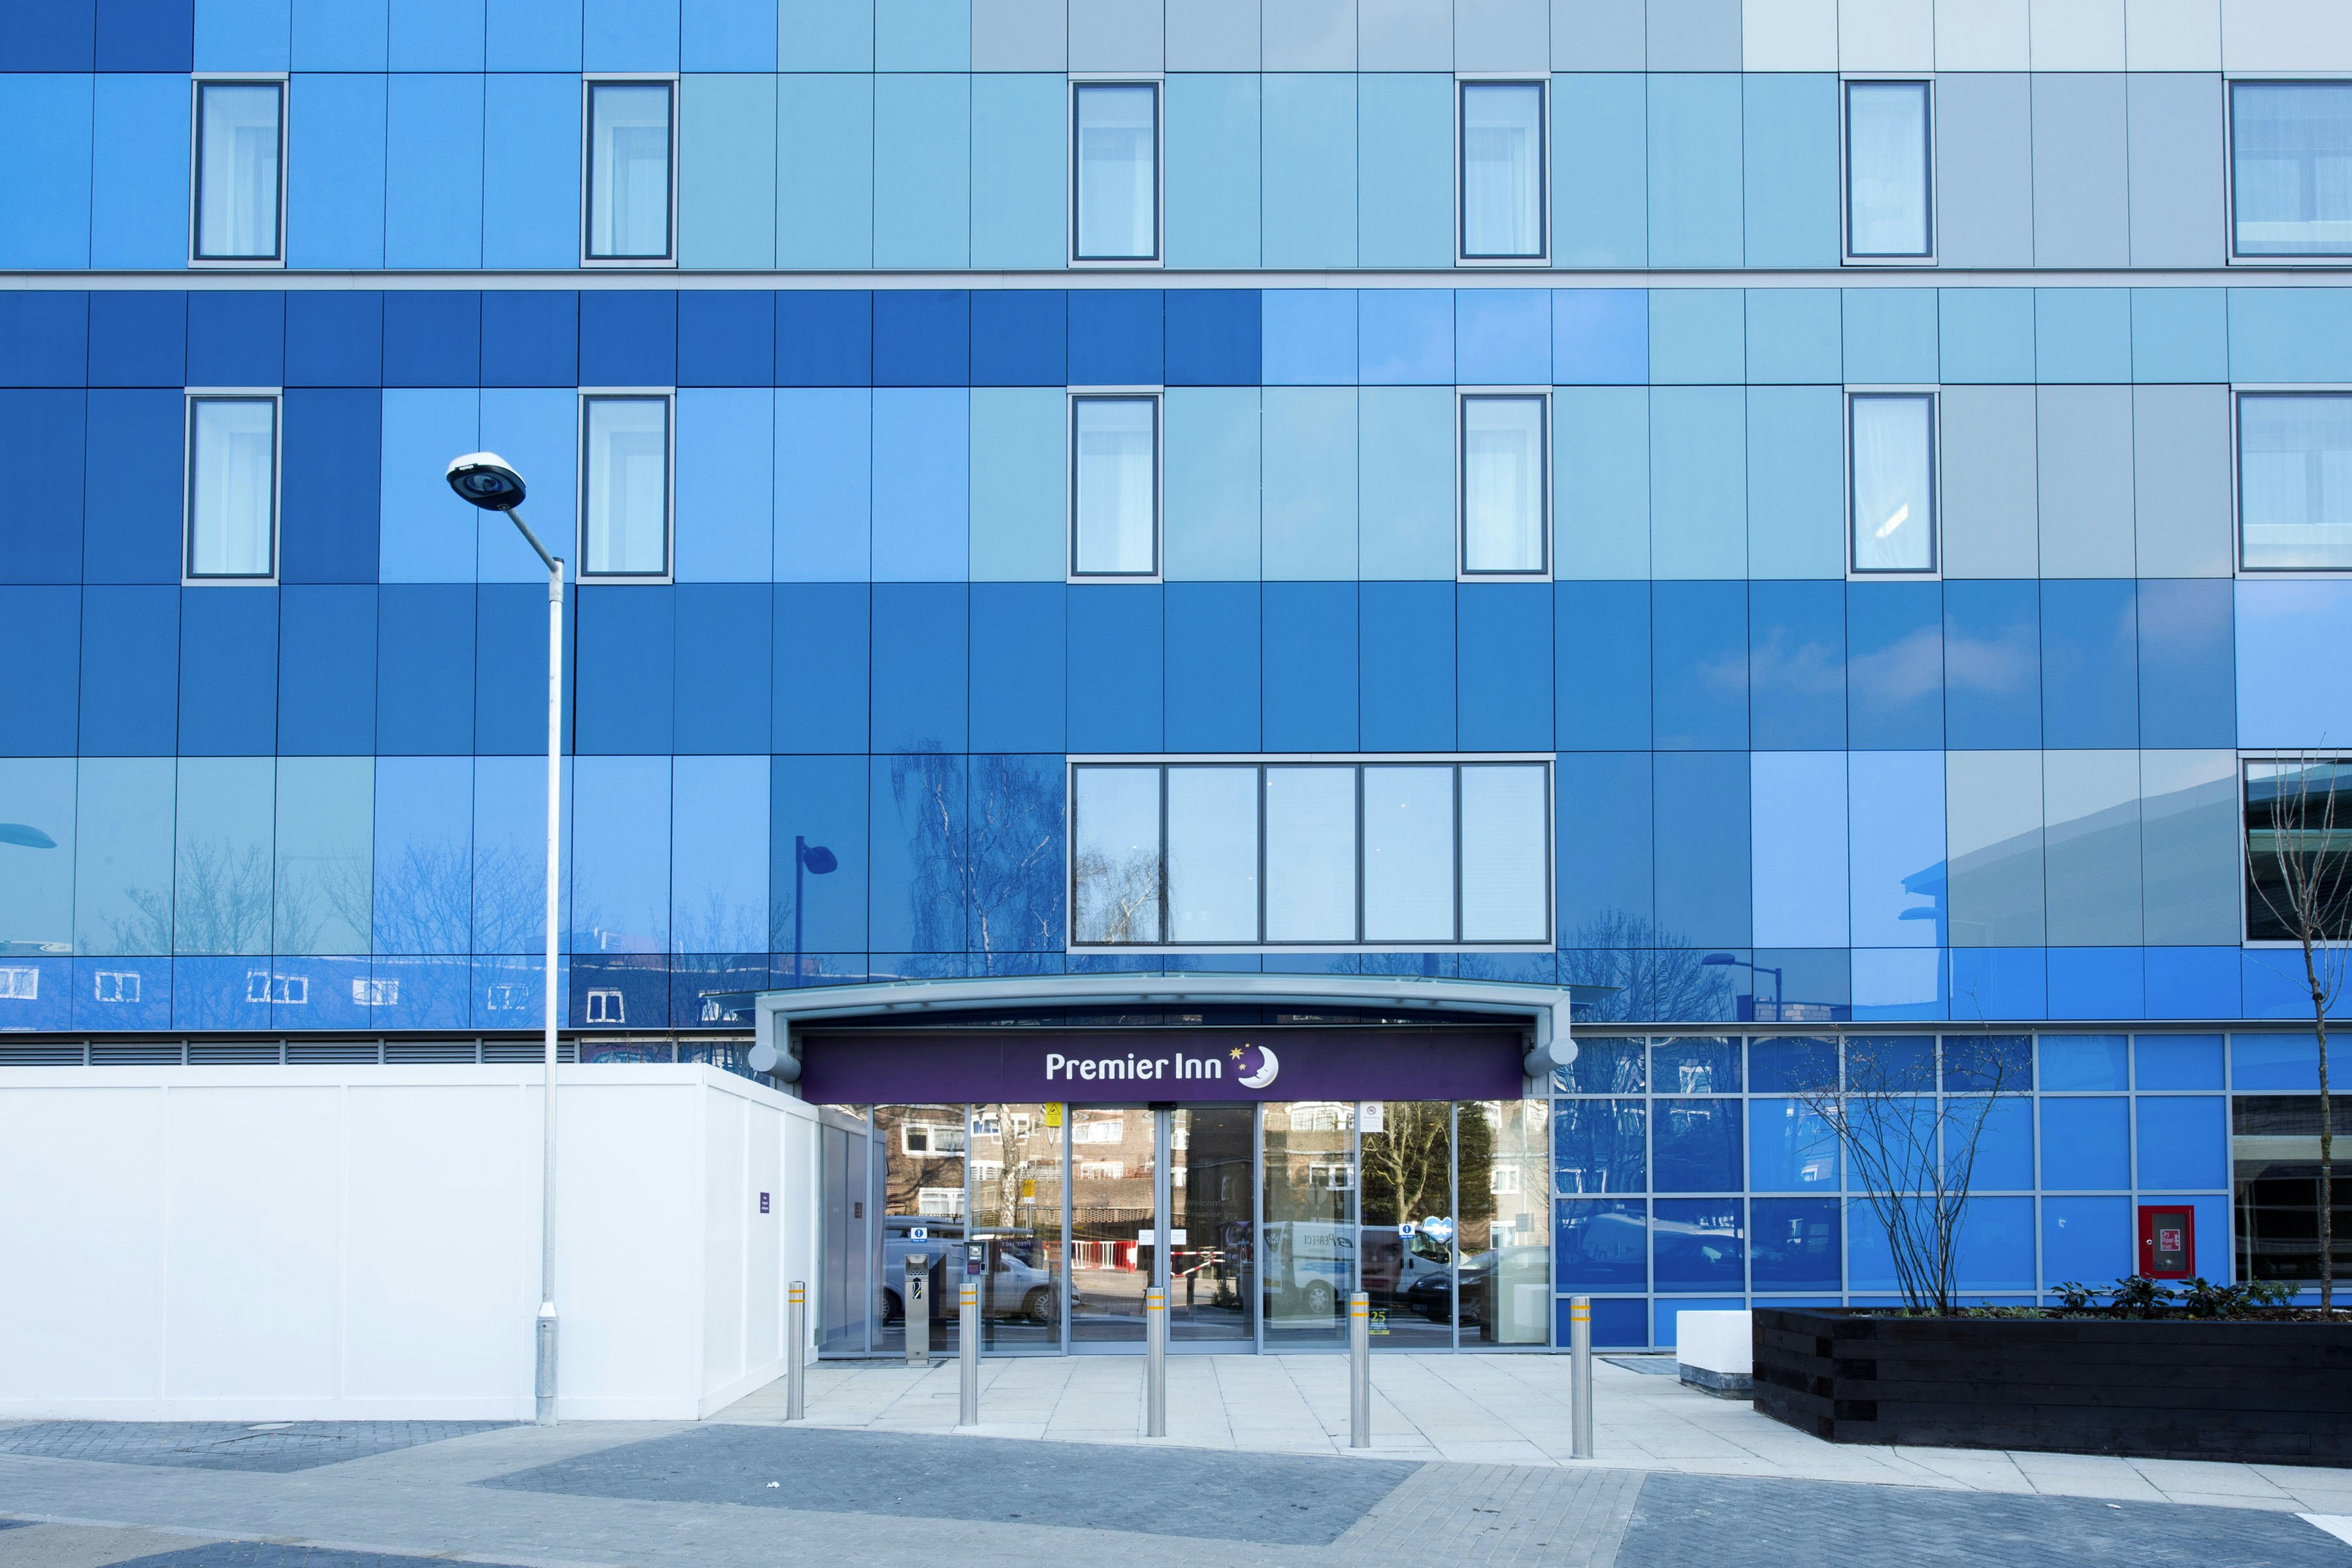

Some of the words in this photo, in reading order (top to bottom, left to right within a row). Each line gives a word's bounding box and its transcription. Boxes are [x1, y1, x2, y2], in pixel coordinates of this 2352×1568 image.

[1046, 1053, 1169, 1080] Premier
[1175, 1053, 1222, 1079] Inn
[1370, 1311, 1386, 1322] 25
